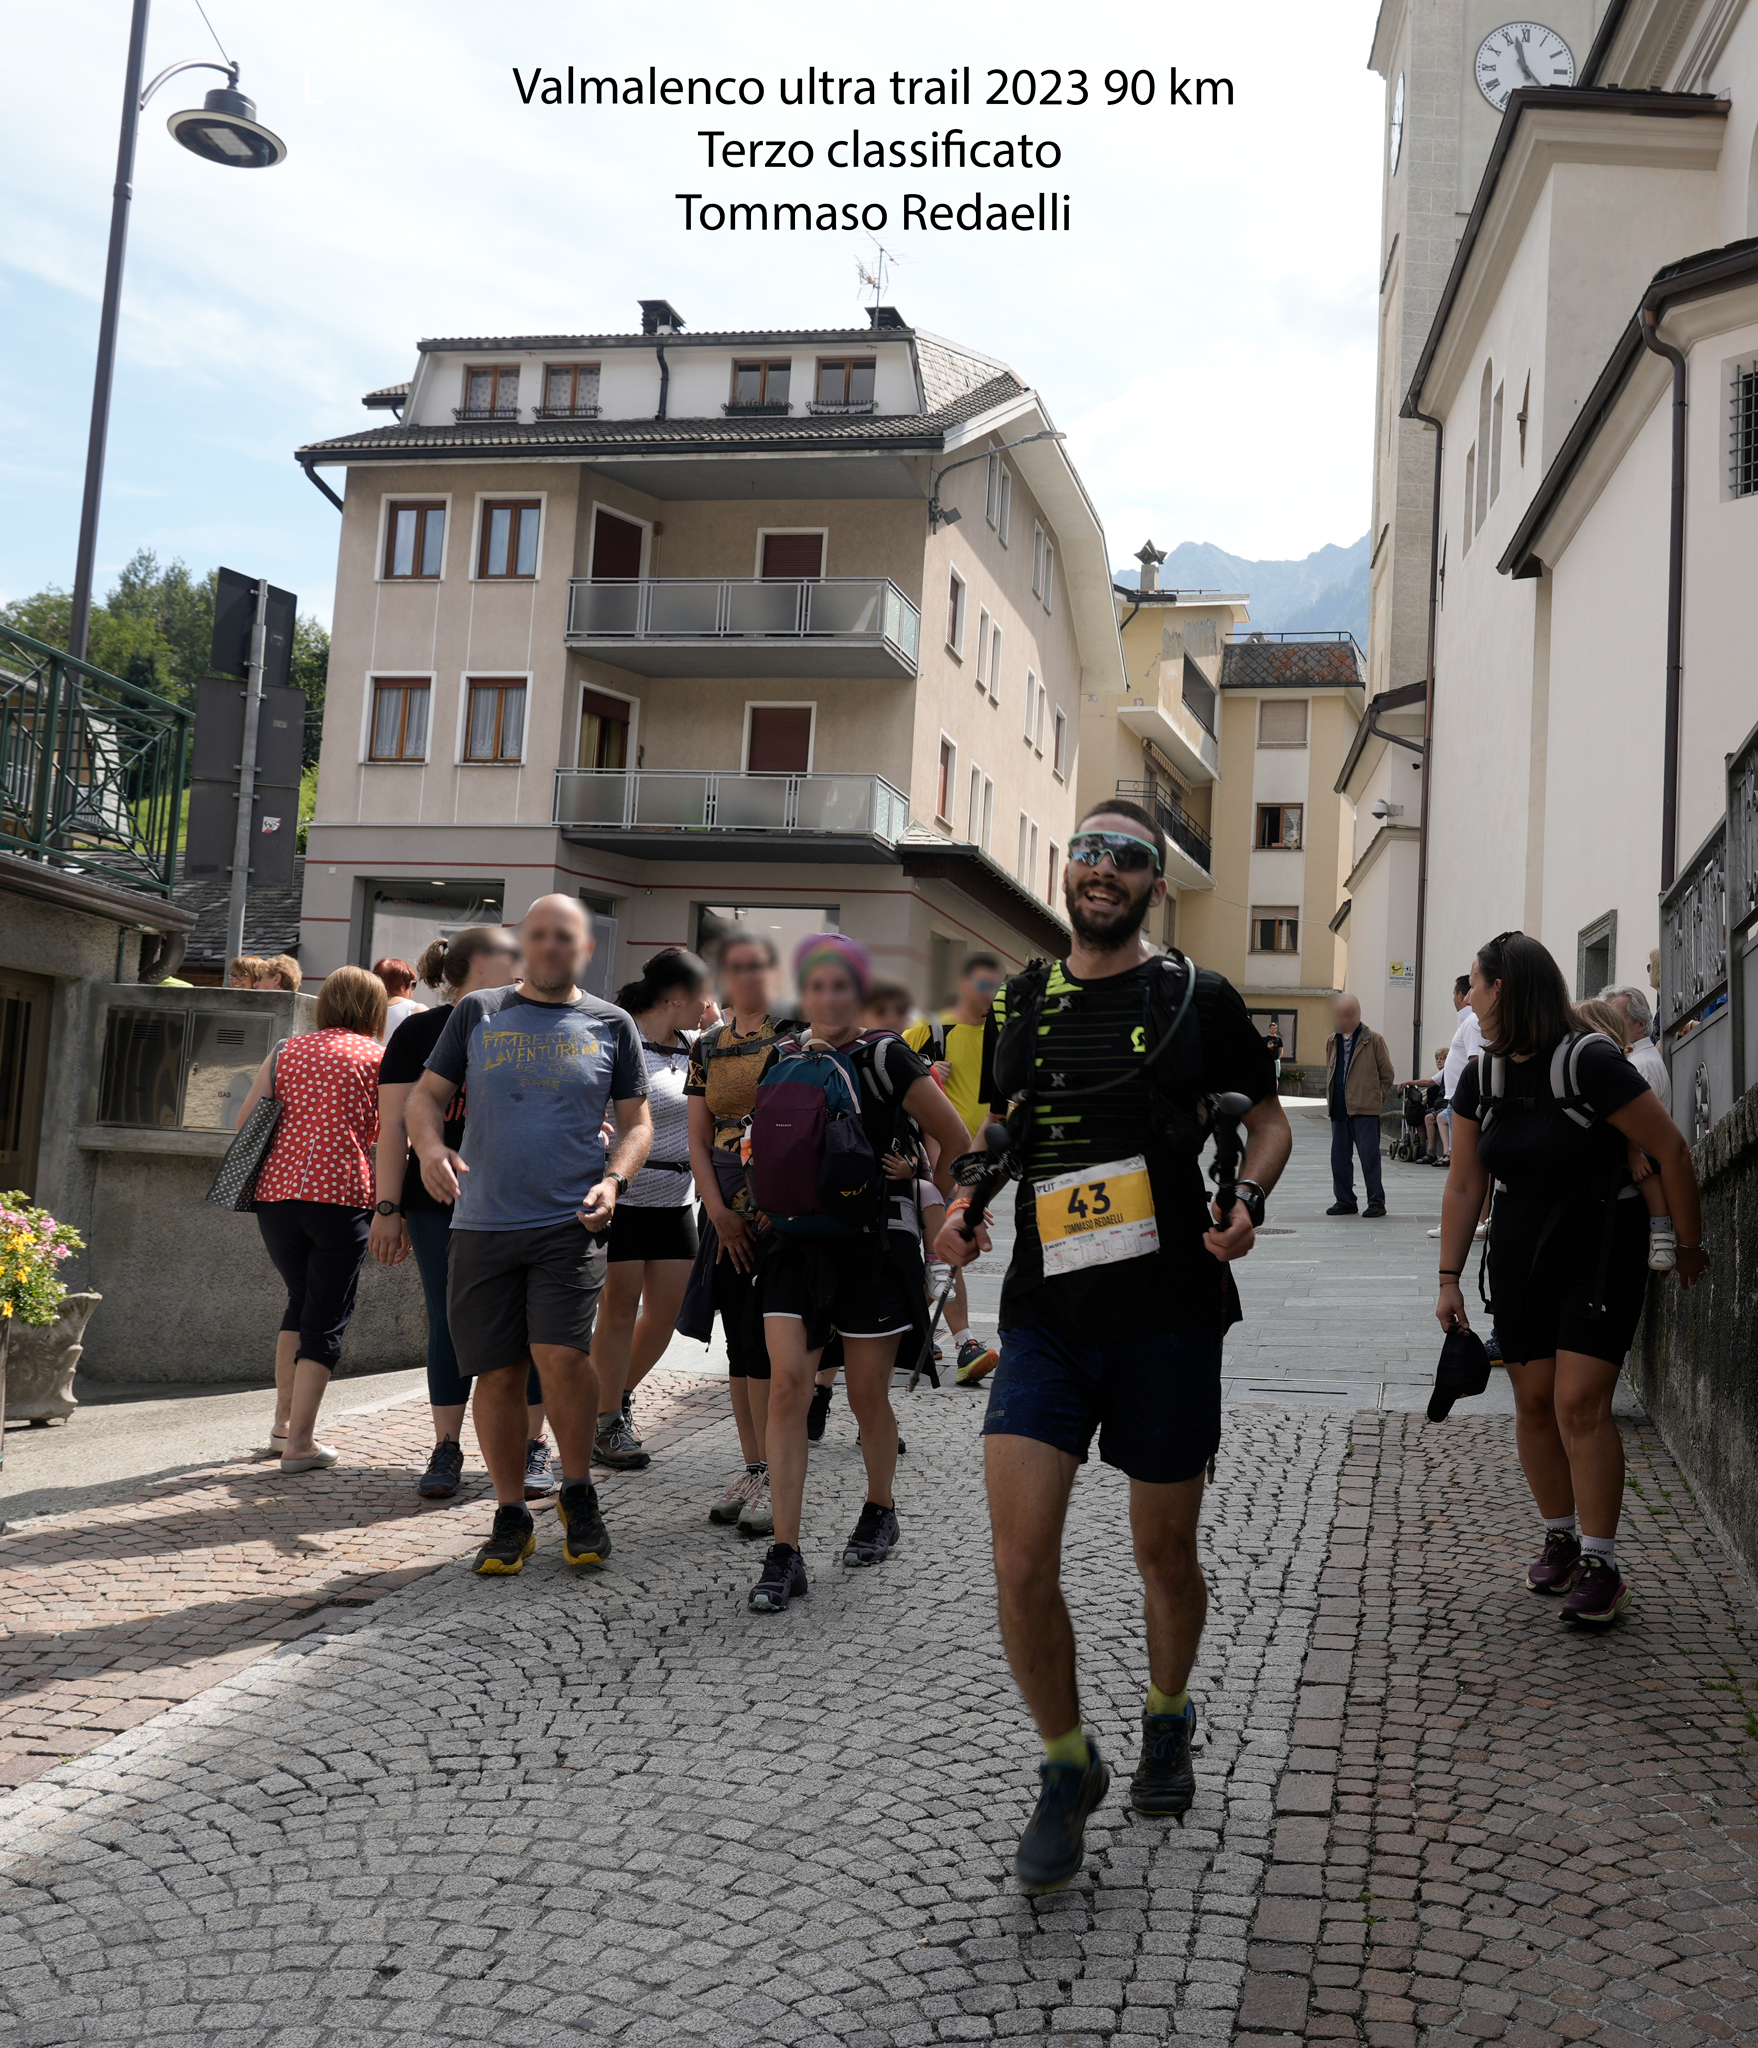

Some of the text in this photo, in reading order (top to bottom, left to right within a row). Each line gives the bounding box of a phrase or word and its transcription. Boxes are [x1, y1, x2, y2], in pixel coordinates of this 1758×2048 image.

[482, 1030, 602, 1051] TIMBERLAND
[1036, 1183, 1055, 1194] VUT
[1068, 1182, 1111, 1218] 43
[1063, 1212, 1124, 1235] TOMMASO REDAELLI
